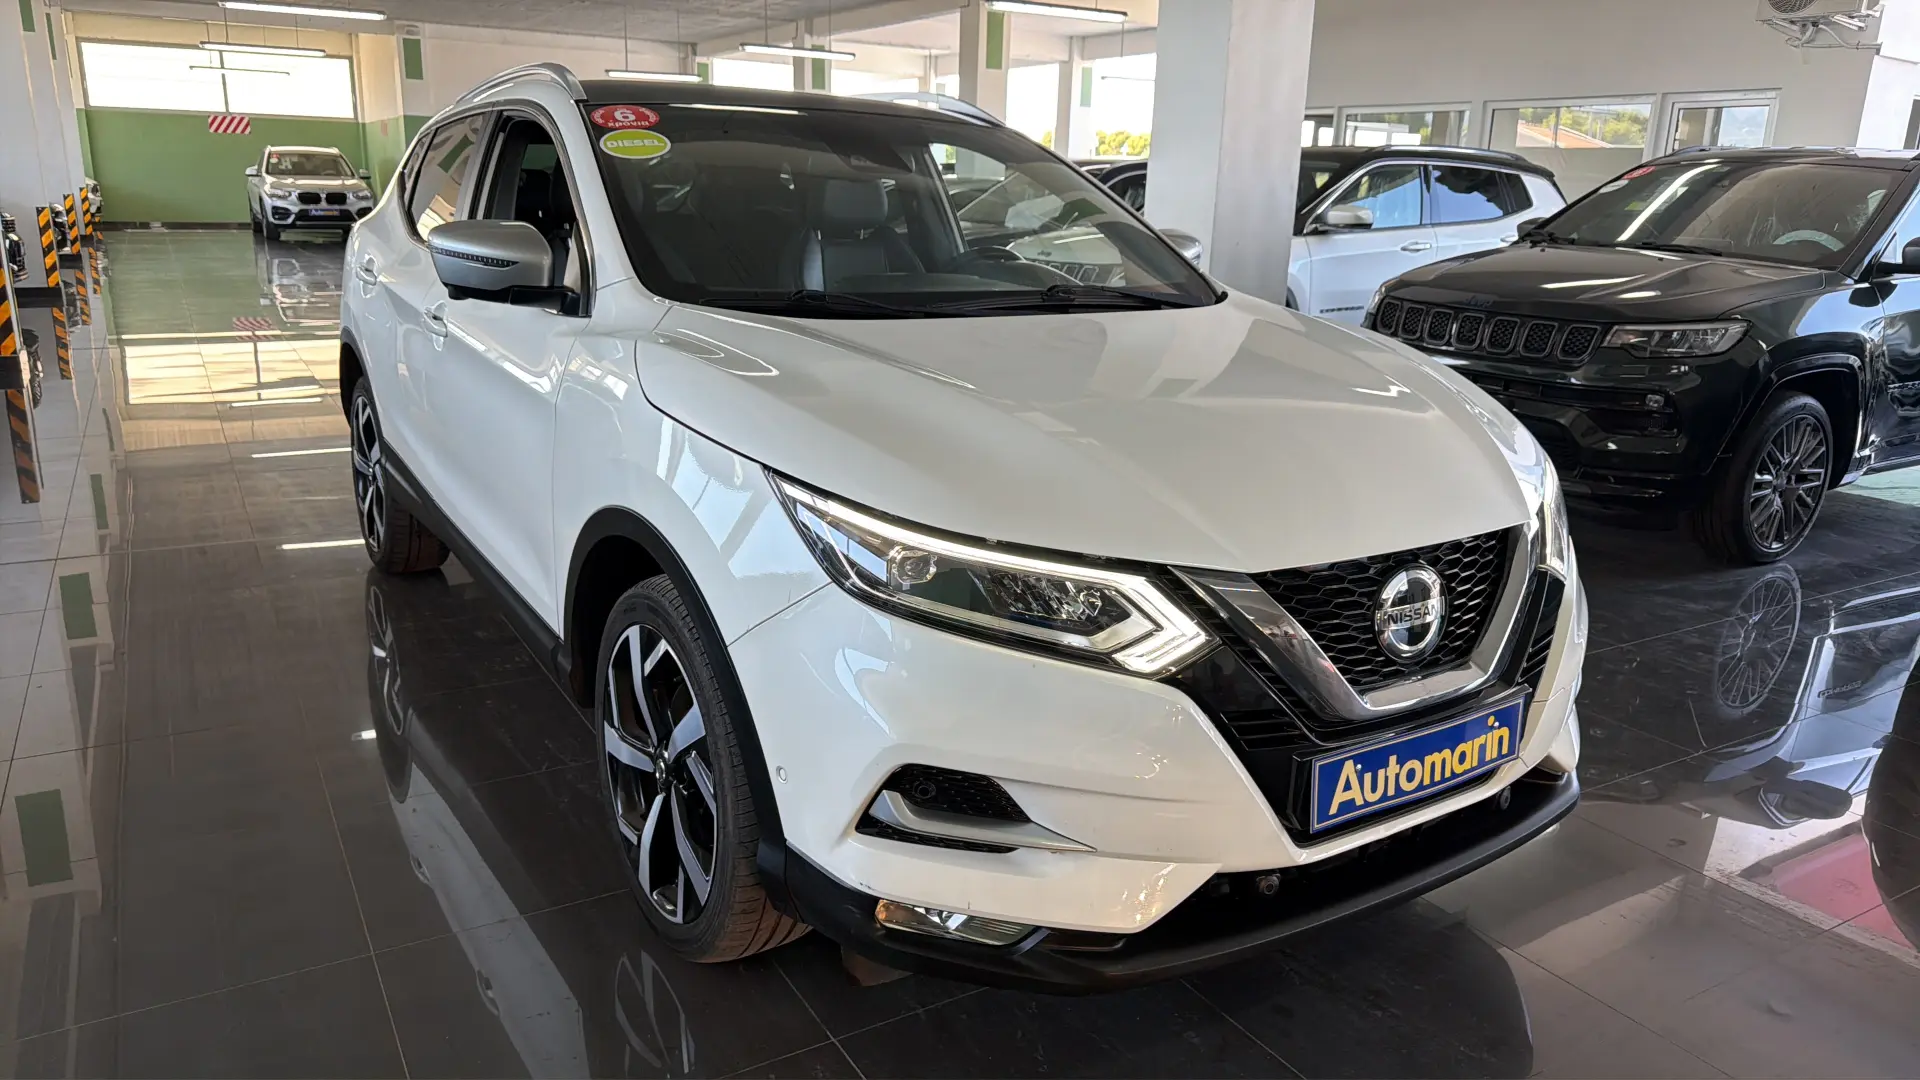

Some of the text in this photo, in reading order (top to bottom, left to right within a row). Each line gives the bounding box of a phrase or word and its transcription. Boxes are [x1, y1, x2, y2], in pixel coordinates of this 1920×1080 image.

[613, 107, 636, 121] 6
[606, 139, 665, 148] DIESEL
[1387, 603, 1438, 625] NISSAN
[1328, 715, 1509, 815] Automarin
